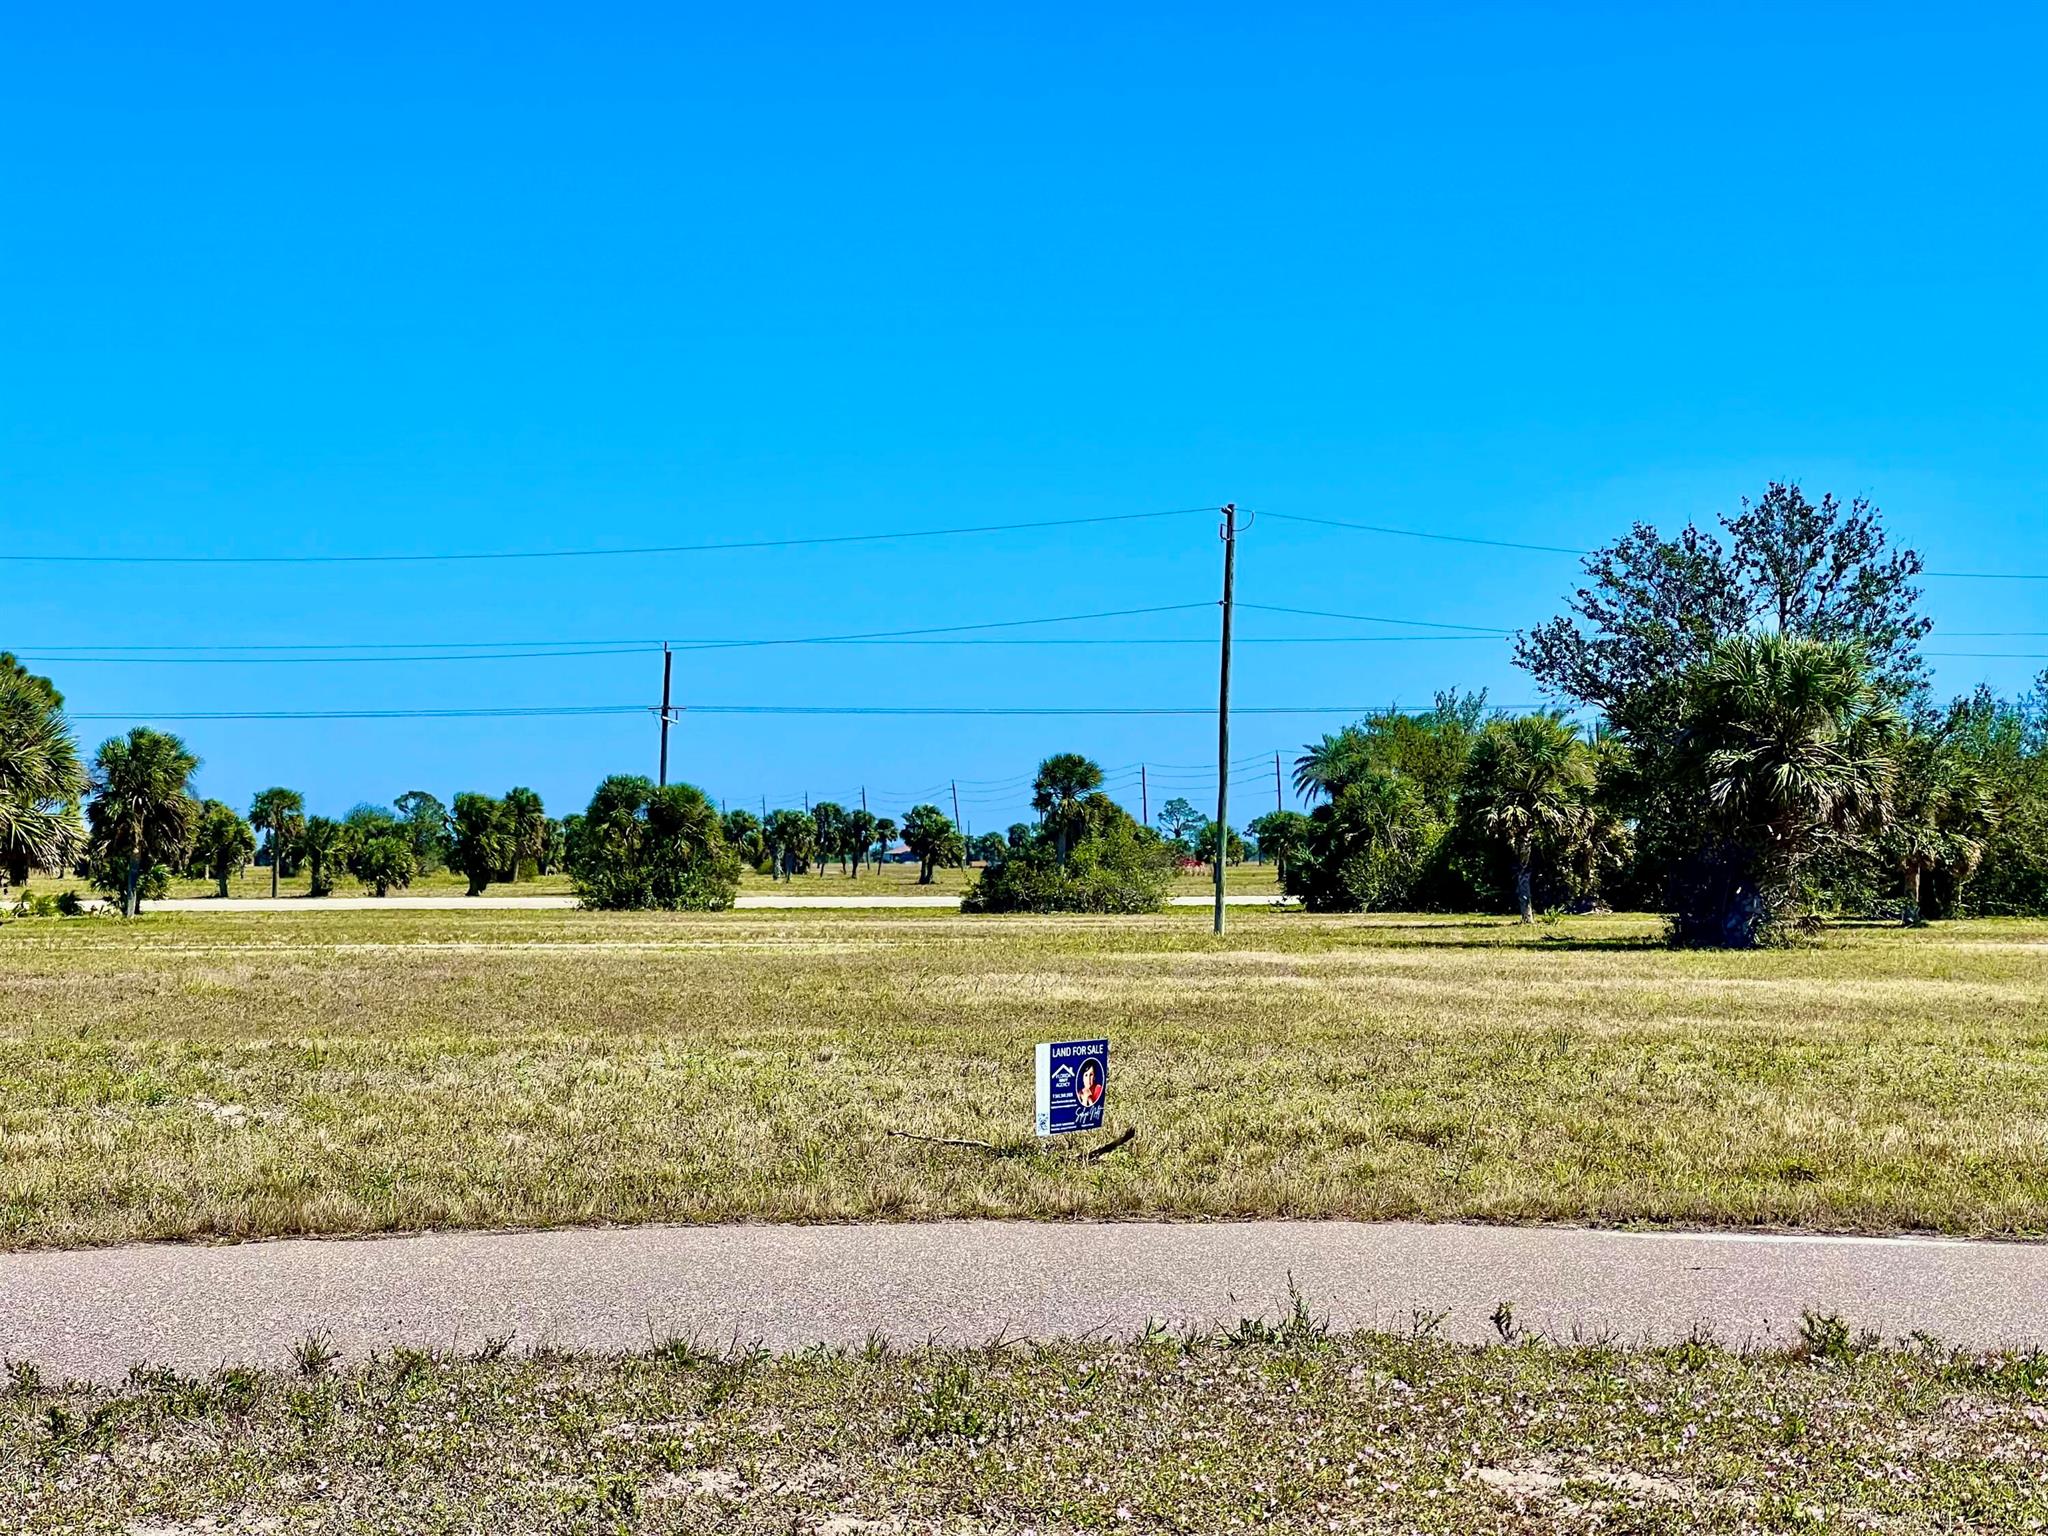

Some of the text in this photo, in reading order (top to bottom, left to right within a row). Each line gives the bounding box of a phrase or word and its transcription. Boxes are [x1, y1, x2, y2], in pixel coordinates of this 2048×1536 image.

[1052, 1044, 1104, 1058] LAND FOR SALE
